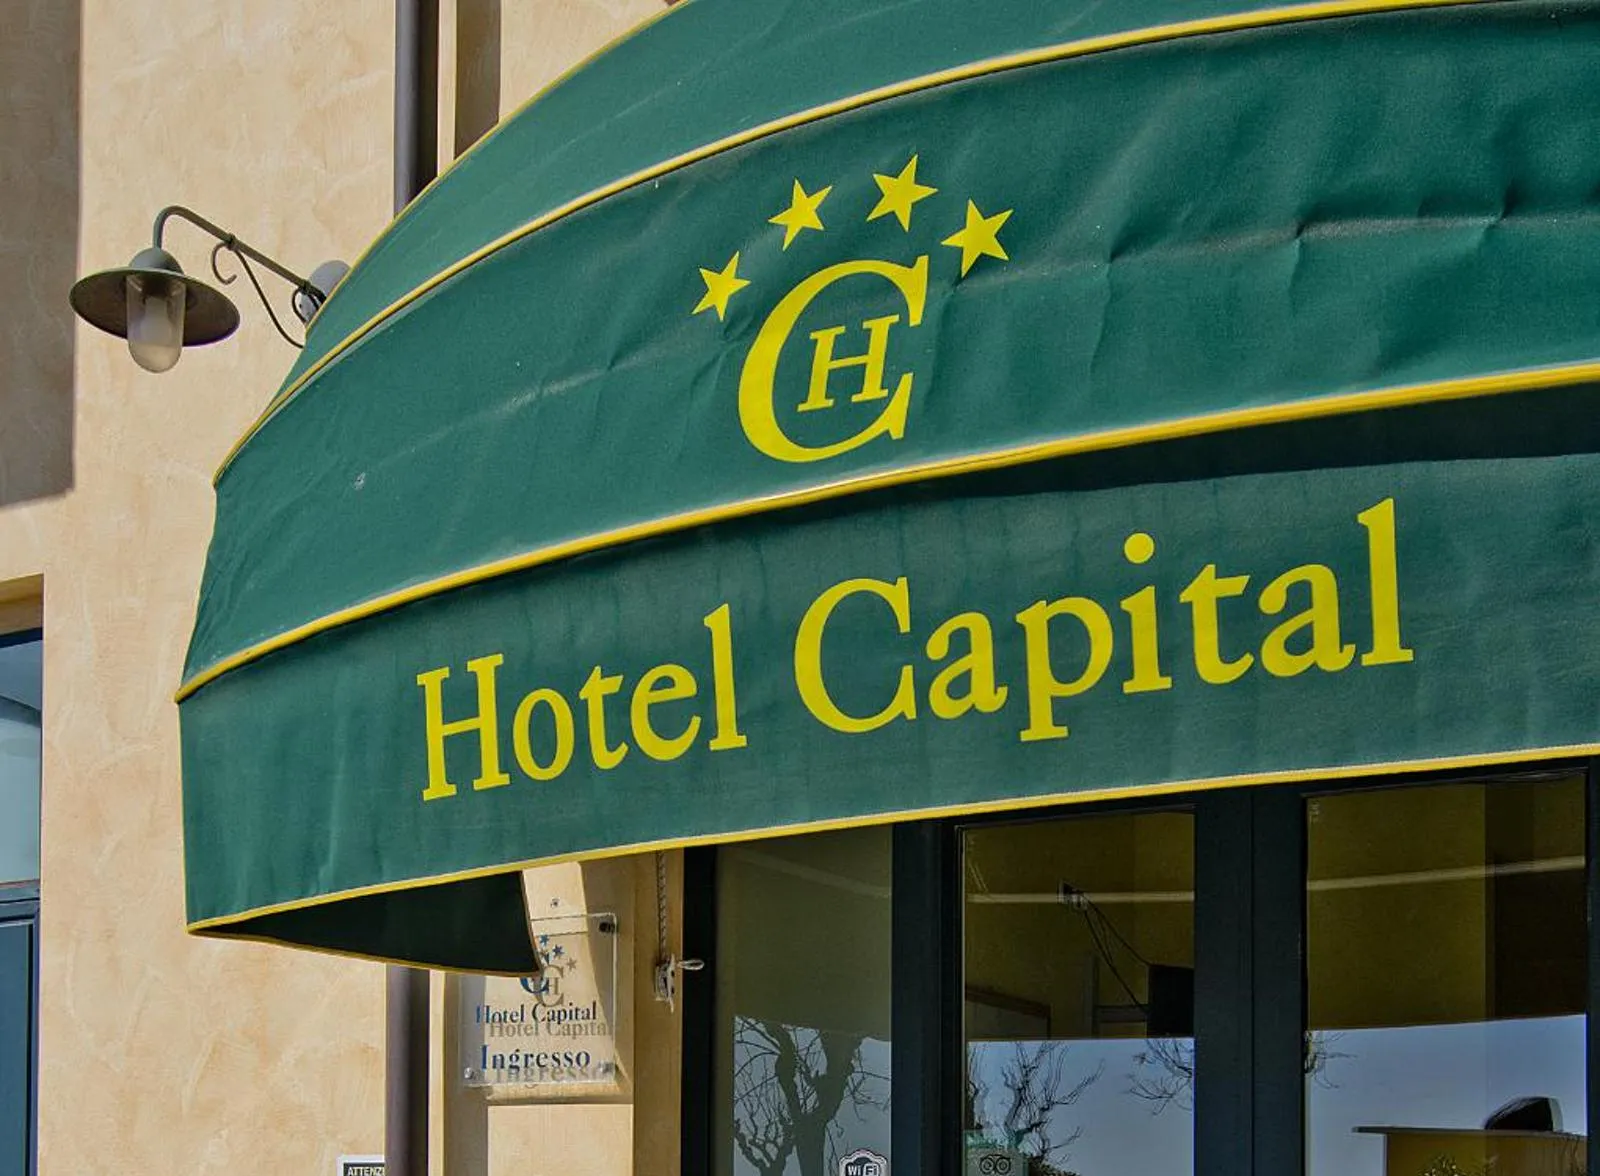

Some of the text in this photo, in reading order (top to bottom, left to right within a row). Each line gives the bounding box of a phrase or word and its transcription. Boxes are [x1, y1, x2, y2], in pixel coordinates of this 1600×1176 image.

[417, 498, 1414, 801] Hotel Capital
[476, 1000, 597, 1025] Hotel Capital
[481, 1044, 591, 1073] Ingresso
